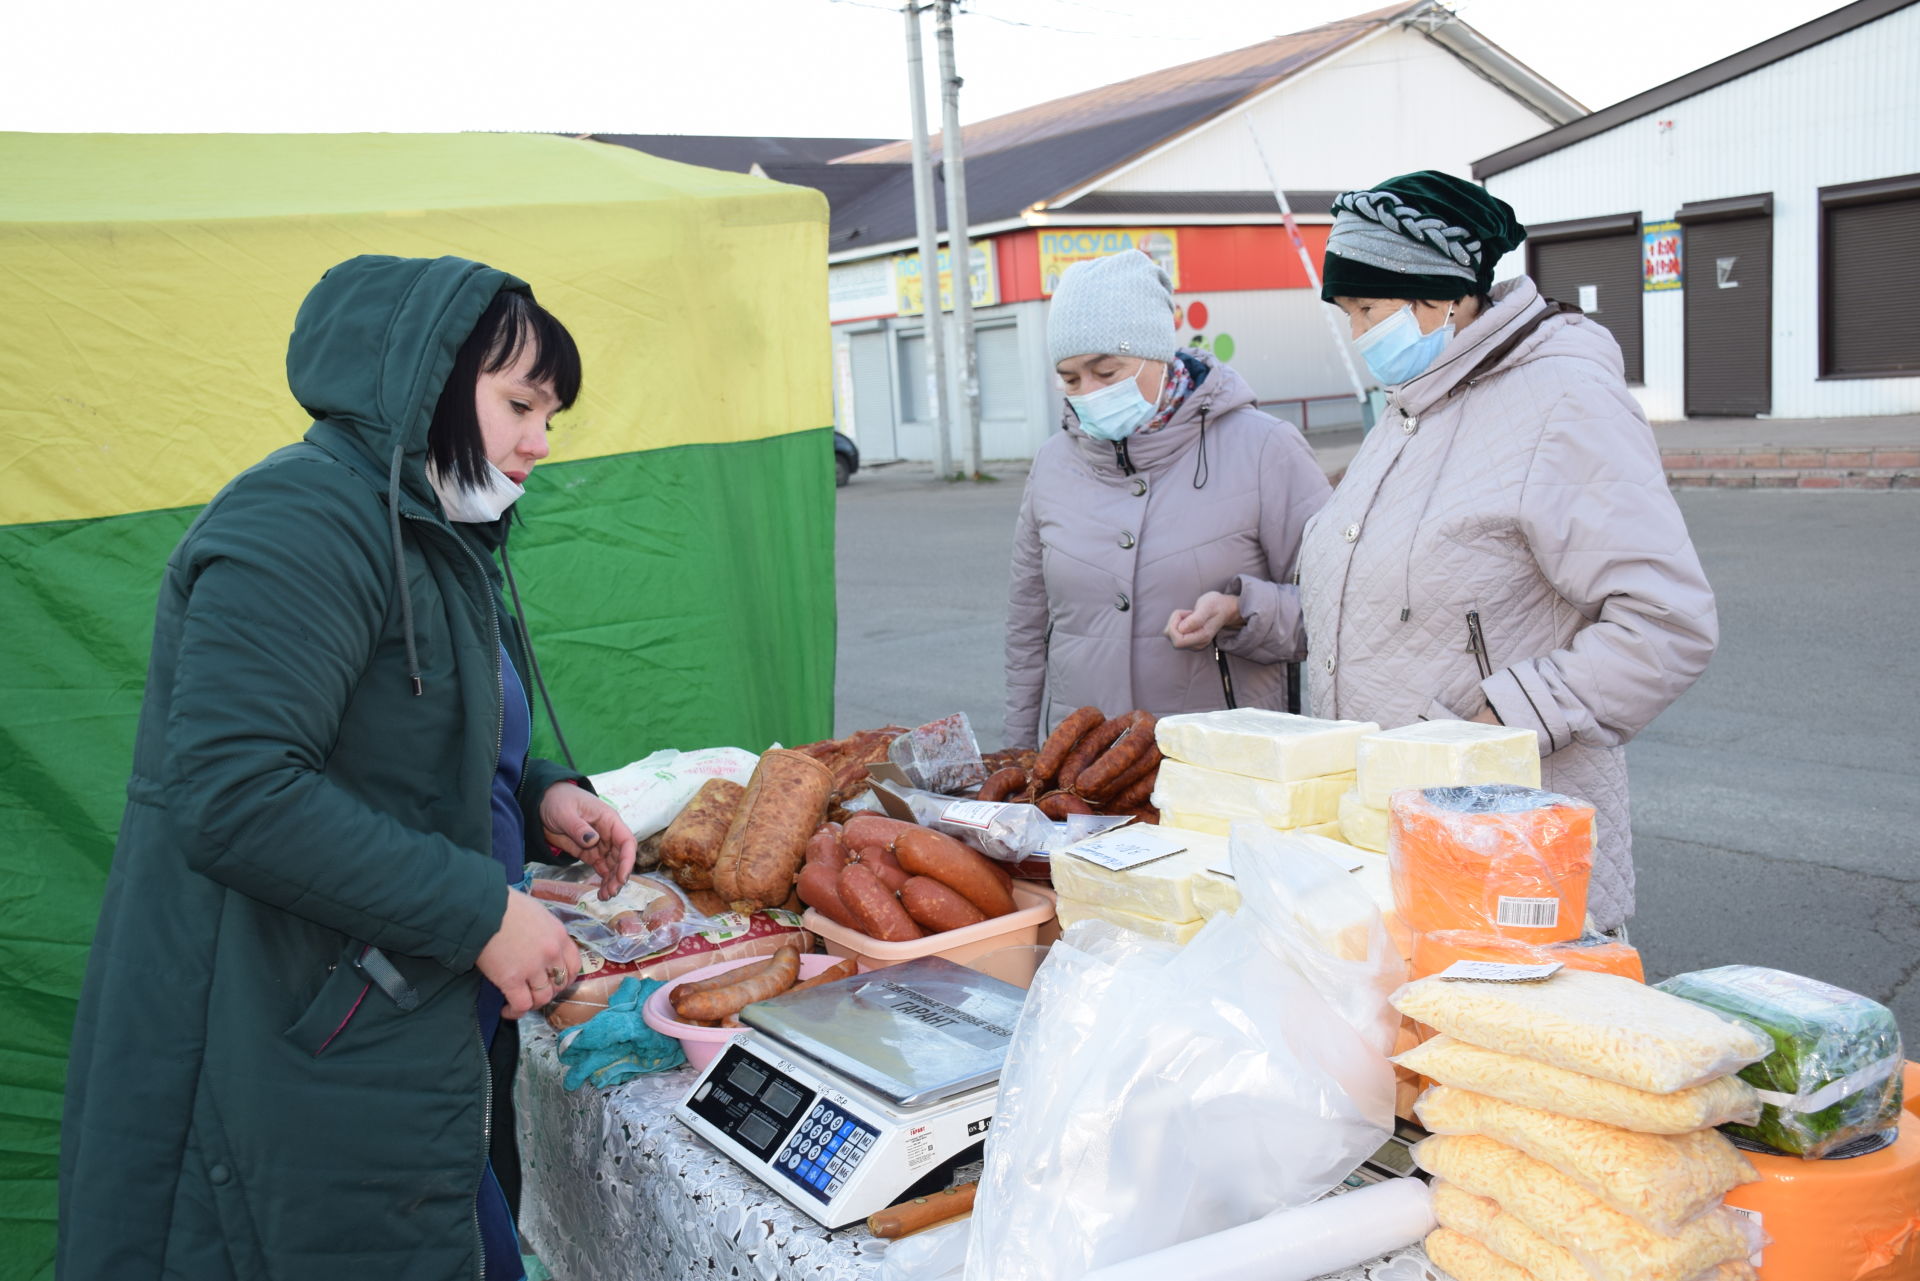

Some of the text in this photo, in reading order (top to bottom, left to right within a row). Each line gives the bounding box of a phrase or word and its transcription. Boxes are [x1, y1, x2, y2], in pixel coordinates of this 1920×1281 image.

[1042, 233, 1134, 254] ПОСУДА
[882, 982, 1013, 1037] ЭЛЕКТРОННЫЕ ТОРГОВЫЕ ВЕСЫ
[890, 1001, 959, 1028] ГАРАНТ
[851, 1129, 862, 1141] M1
[862, 1136, 872, 1147] M2
[840, 1144, 851, 1156] M3
[851, 1151, 861, 1162] M4
[829, 1160, 839, 1171] M5
[839, 1167, 849, 1178] M6
[828, 1181, 839, 1192] M7
